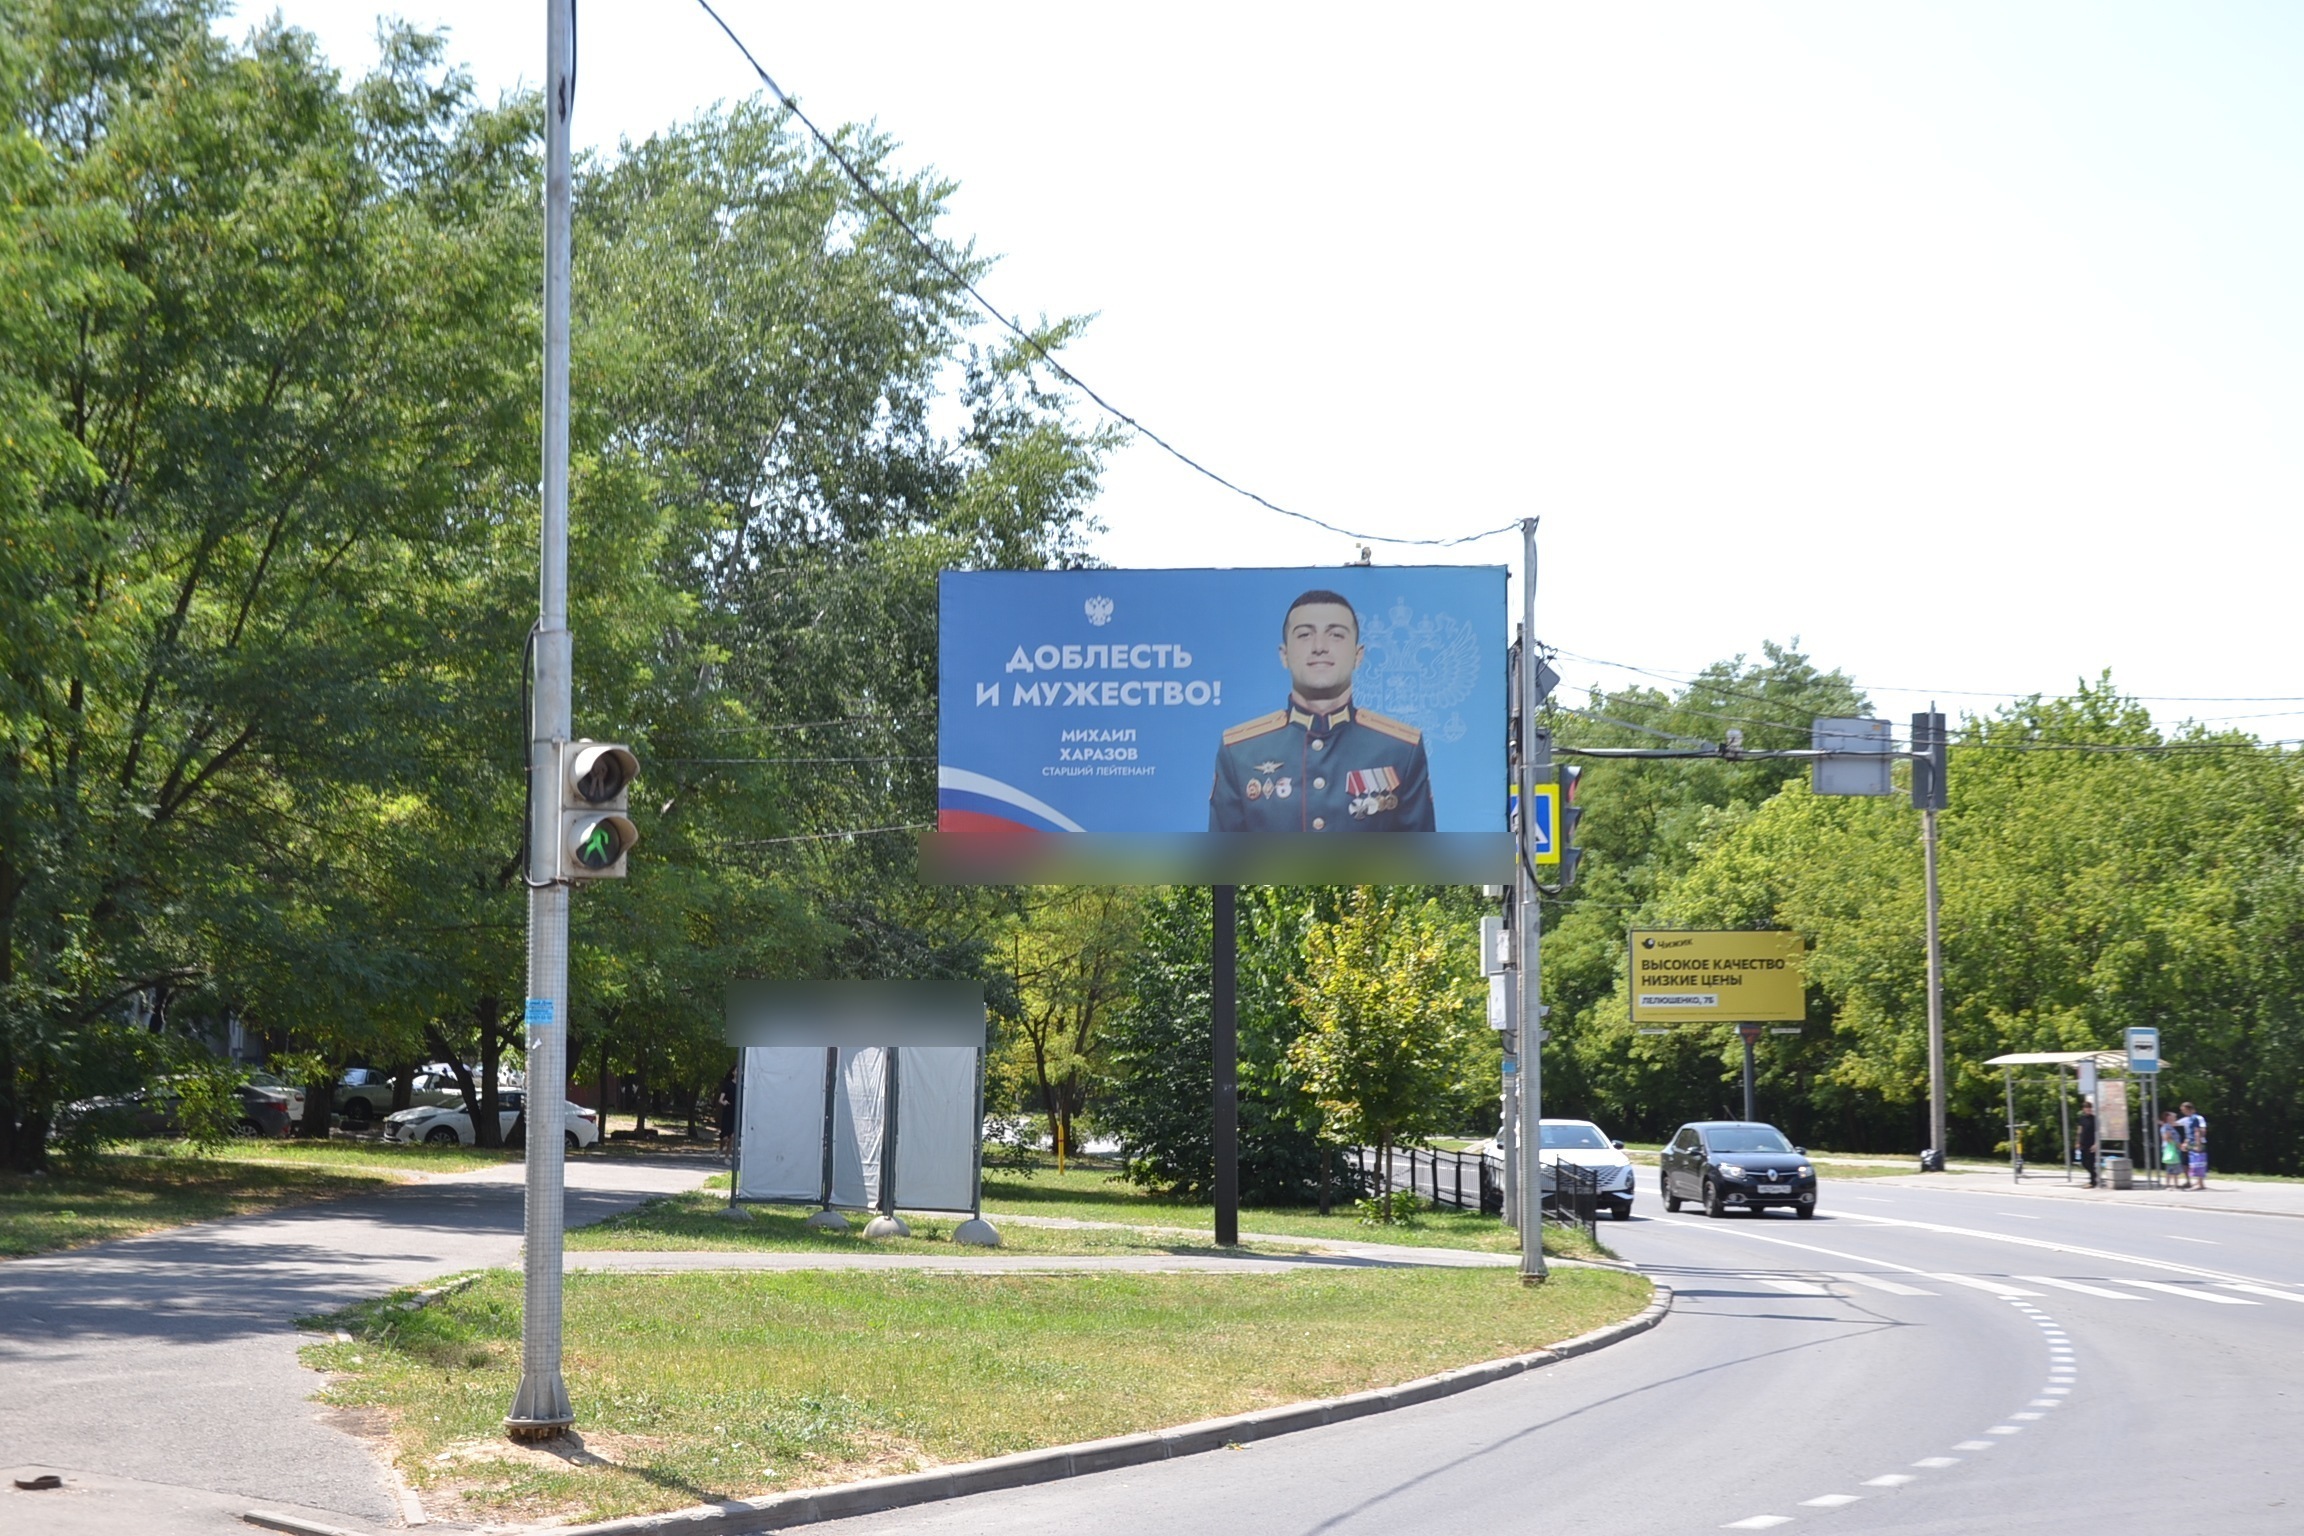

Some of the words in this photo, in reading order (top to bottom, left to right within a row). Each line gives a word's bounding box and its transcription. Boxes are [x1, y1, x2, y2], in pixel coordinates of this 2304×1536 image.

[1005, 644, 1193, 673] ДОБЛЕСТЬ
[976, 681, 1000, 707] И
[1012, 680, 1222, 706] МУЖЕСТВО!
[1061, 729, 1137, 742] МИХАИЛ
[1059, 748, 1138, 761] ХАРАЗОВ
[1041, 765, 1094, 776] СТАРШИЙ
[1095, 765, 1156, 776] ЛЕЙТЕНАНТ
[1641, 959, 1709, 970] ВЫСОКОЕ
[1713, 958, 1785, 970] КАЧЕСТВО
[1641, 975, 1698, 986] НИЗКИЕ
[1701, 975, 1743, 988] ЦЕНЫ
